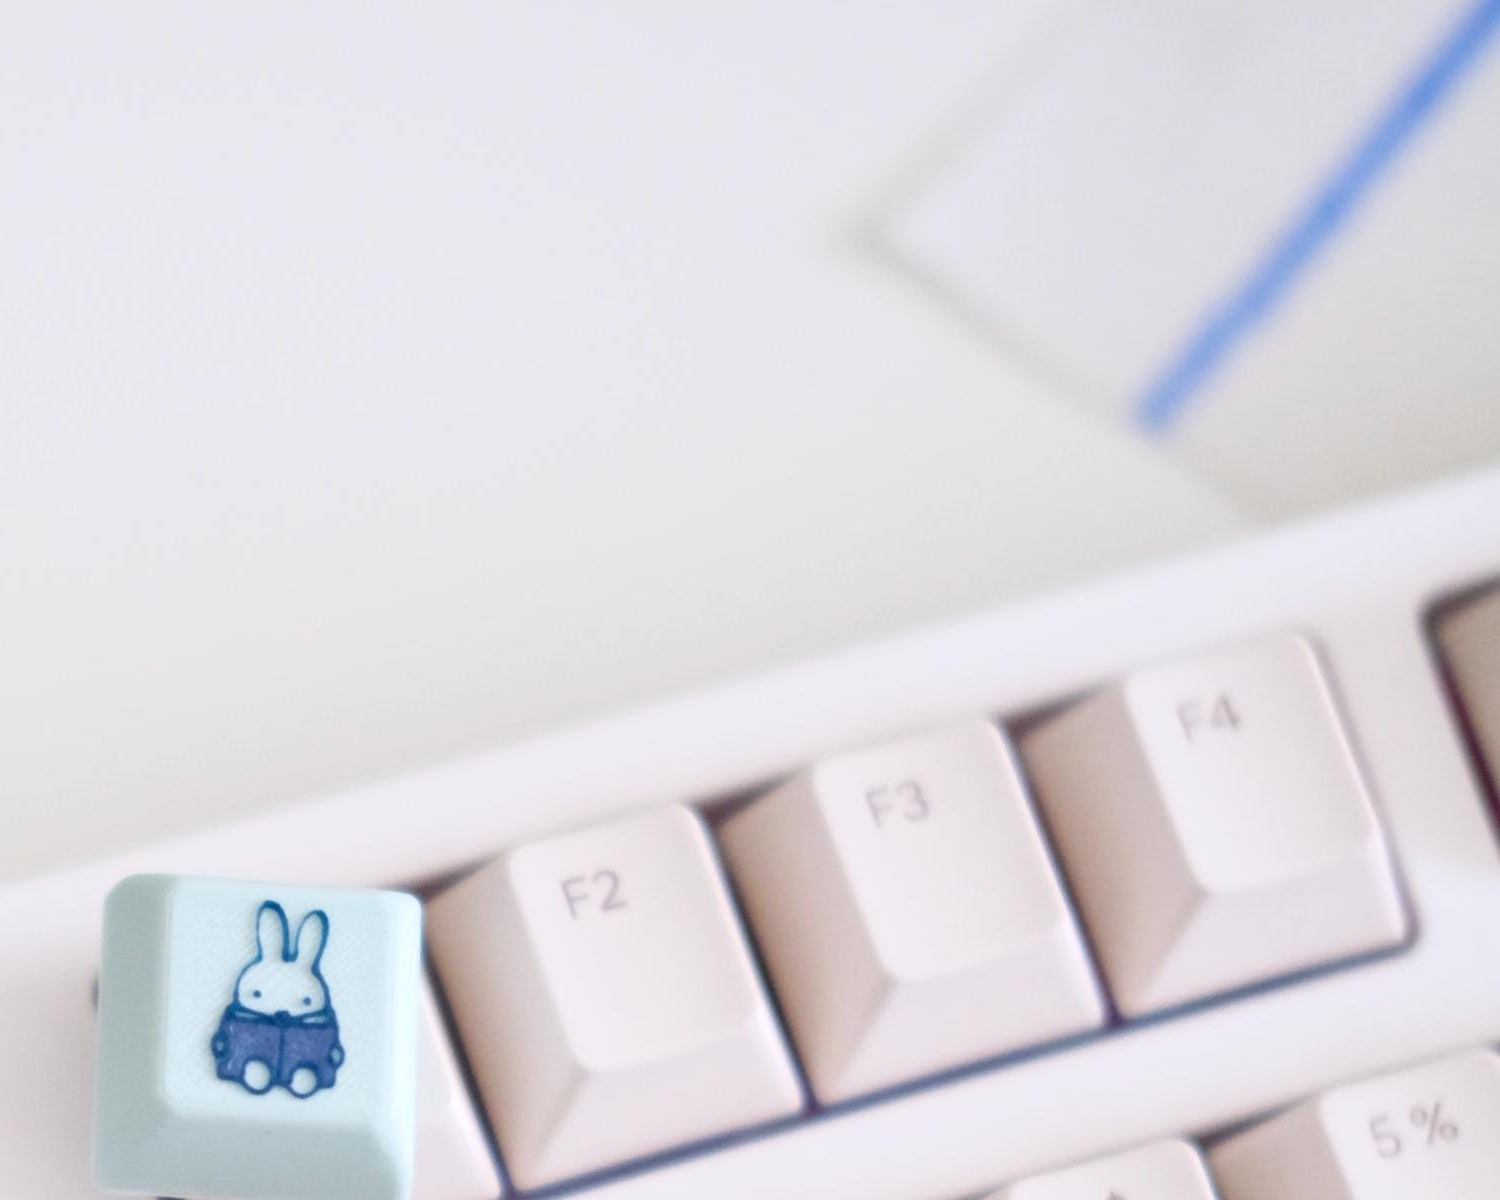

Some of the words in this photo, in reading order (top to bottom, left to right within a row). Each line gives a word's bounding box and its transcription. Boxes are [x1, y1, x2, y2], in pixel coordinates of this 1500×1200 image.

[1175, 690, 1244, 743] F4
[861, 777, 933, 831] F3
[558, 867, 629, 920] F2
